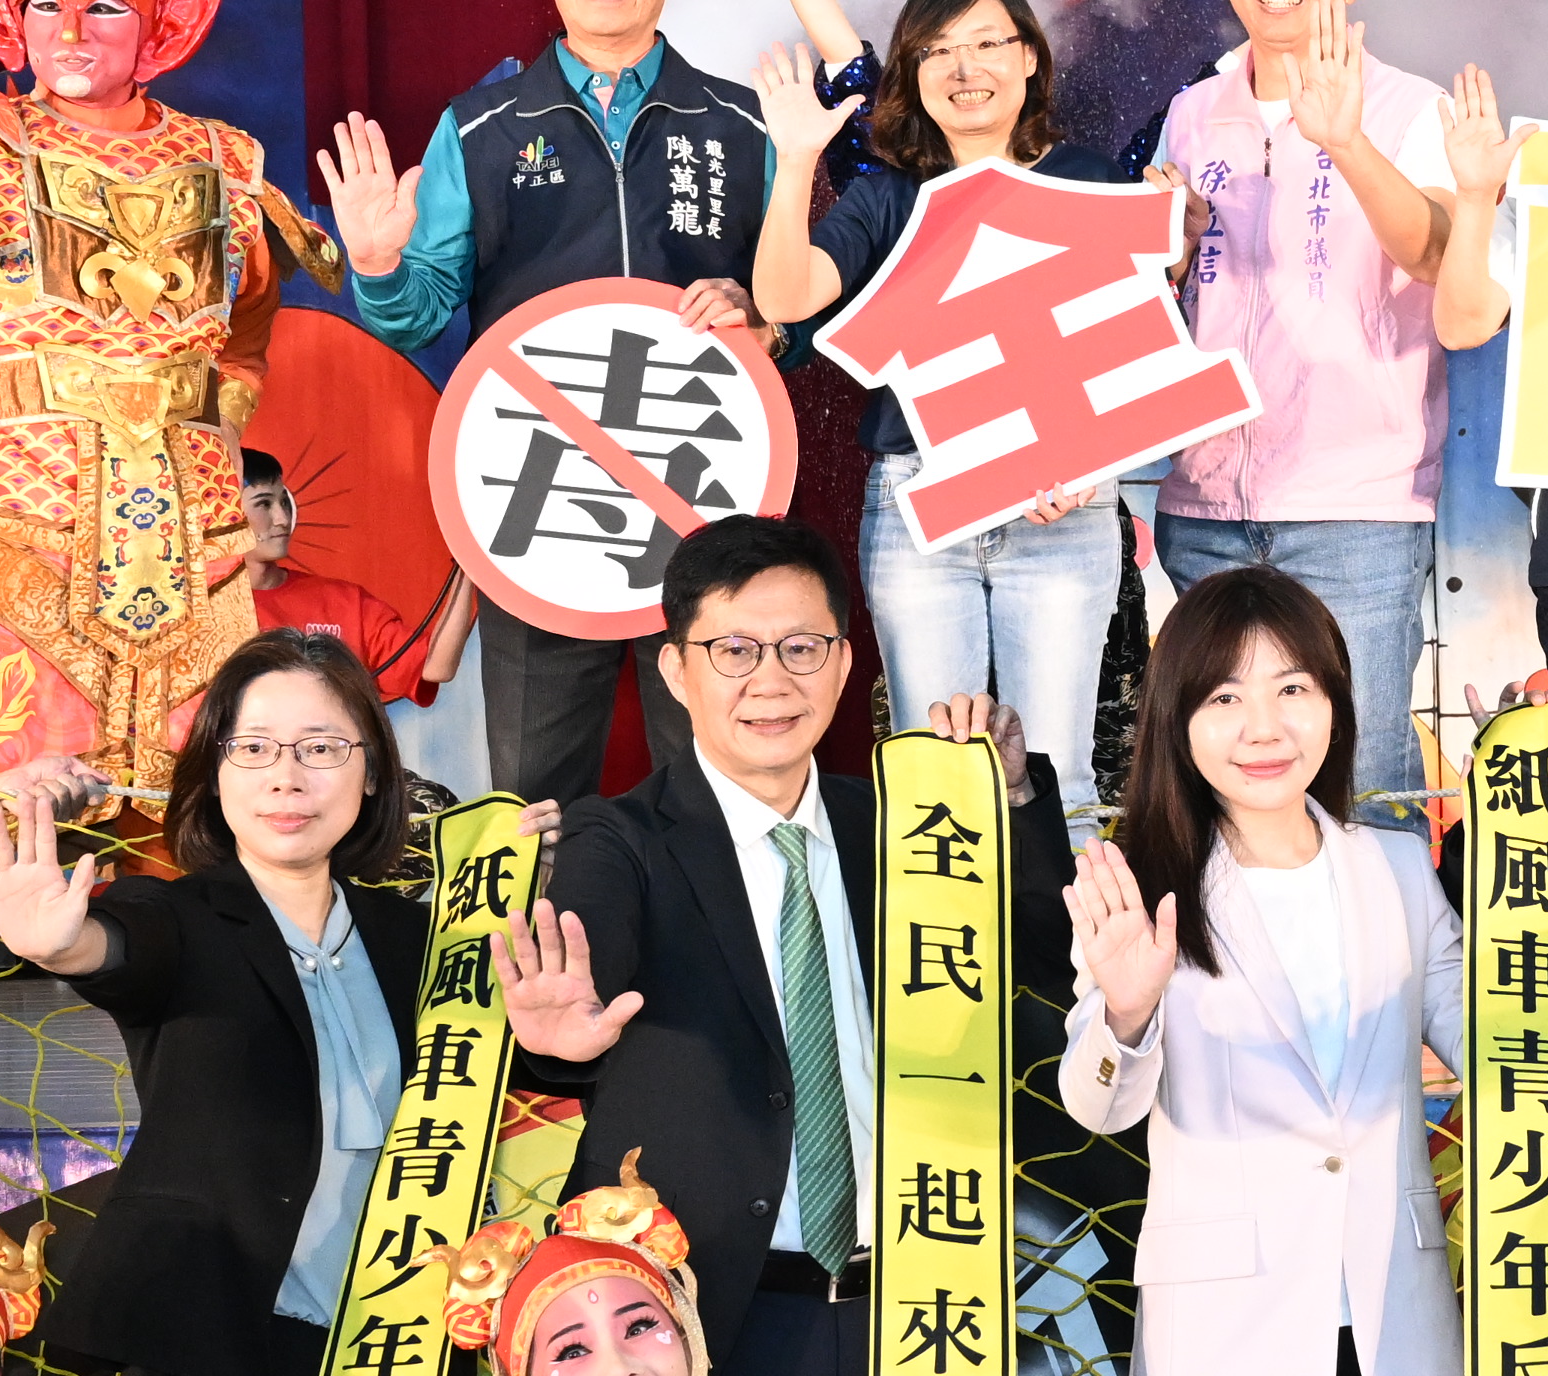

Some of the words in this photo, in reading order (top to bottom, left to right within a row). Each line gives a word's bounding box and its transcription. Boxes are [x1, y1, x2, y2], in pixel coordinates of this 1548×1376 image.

[512, 169, 566, 190] 中正區
[516, 156, 560, 172] TAIPEI
[666, 135, 703, 236] 陳萬龍
[704, 139, 727, 239] 龍光里里長
[490, 329, 745, 590] 毒
